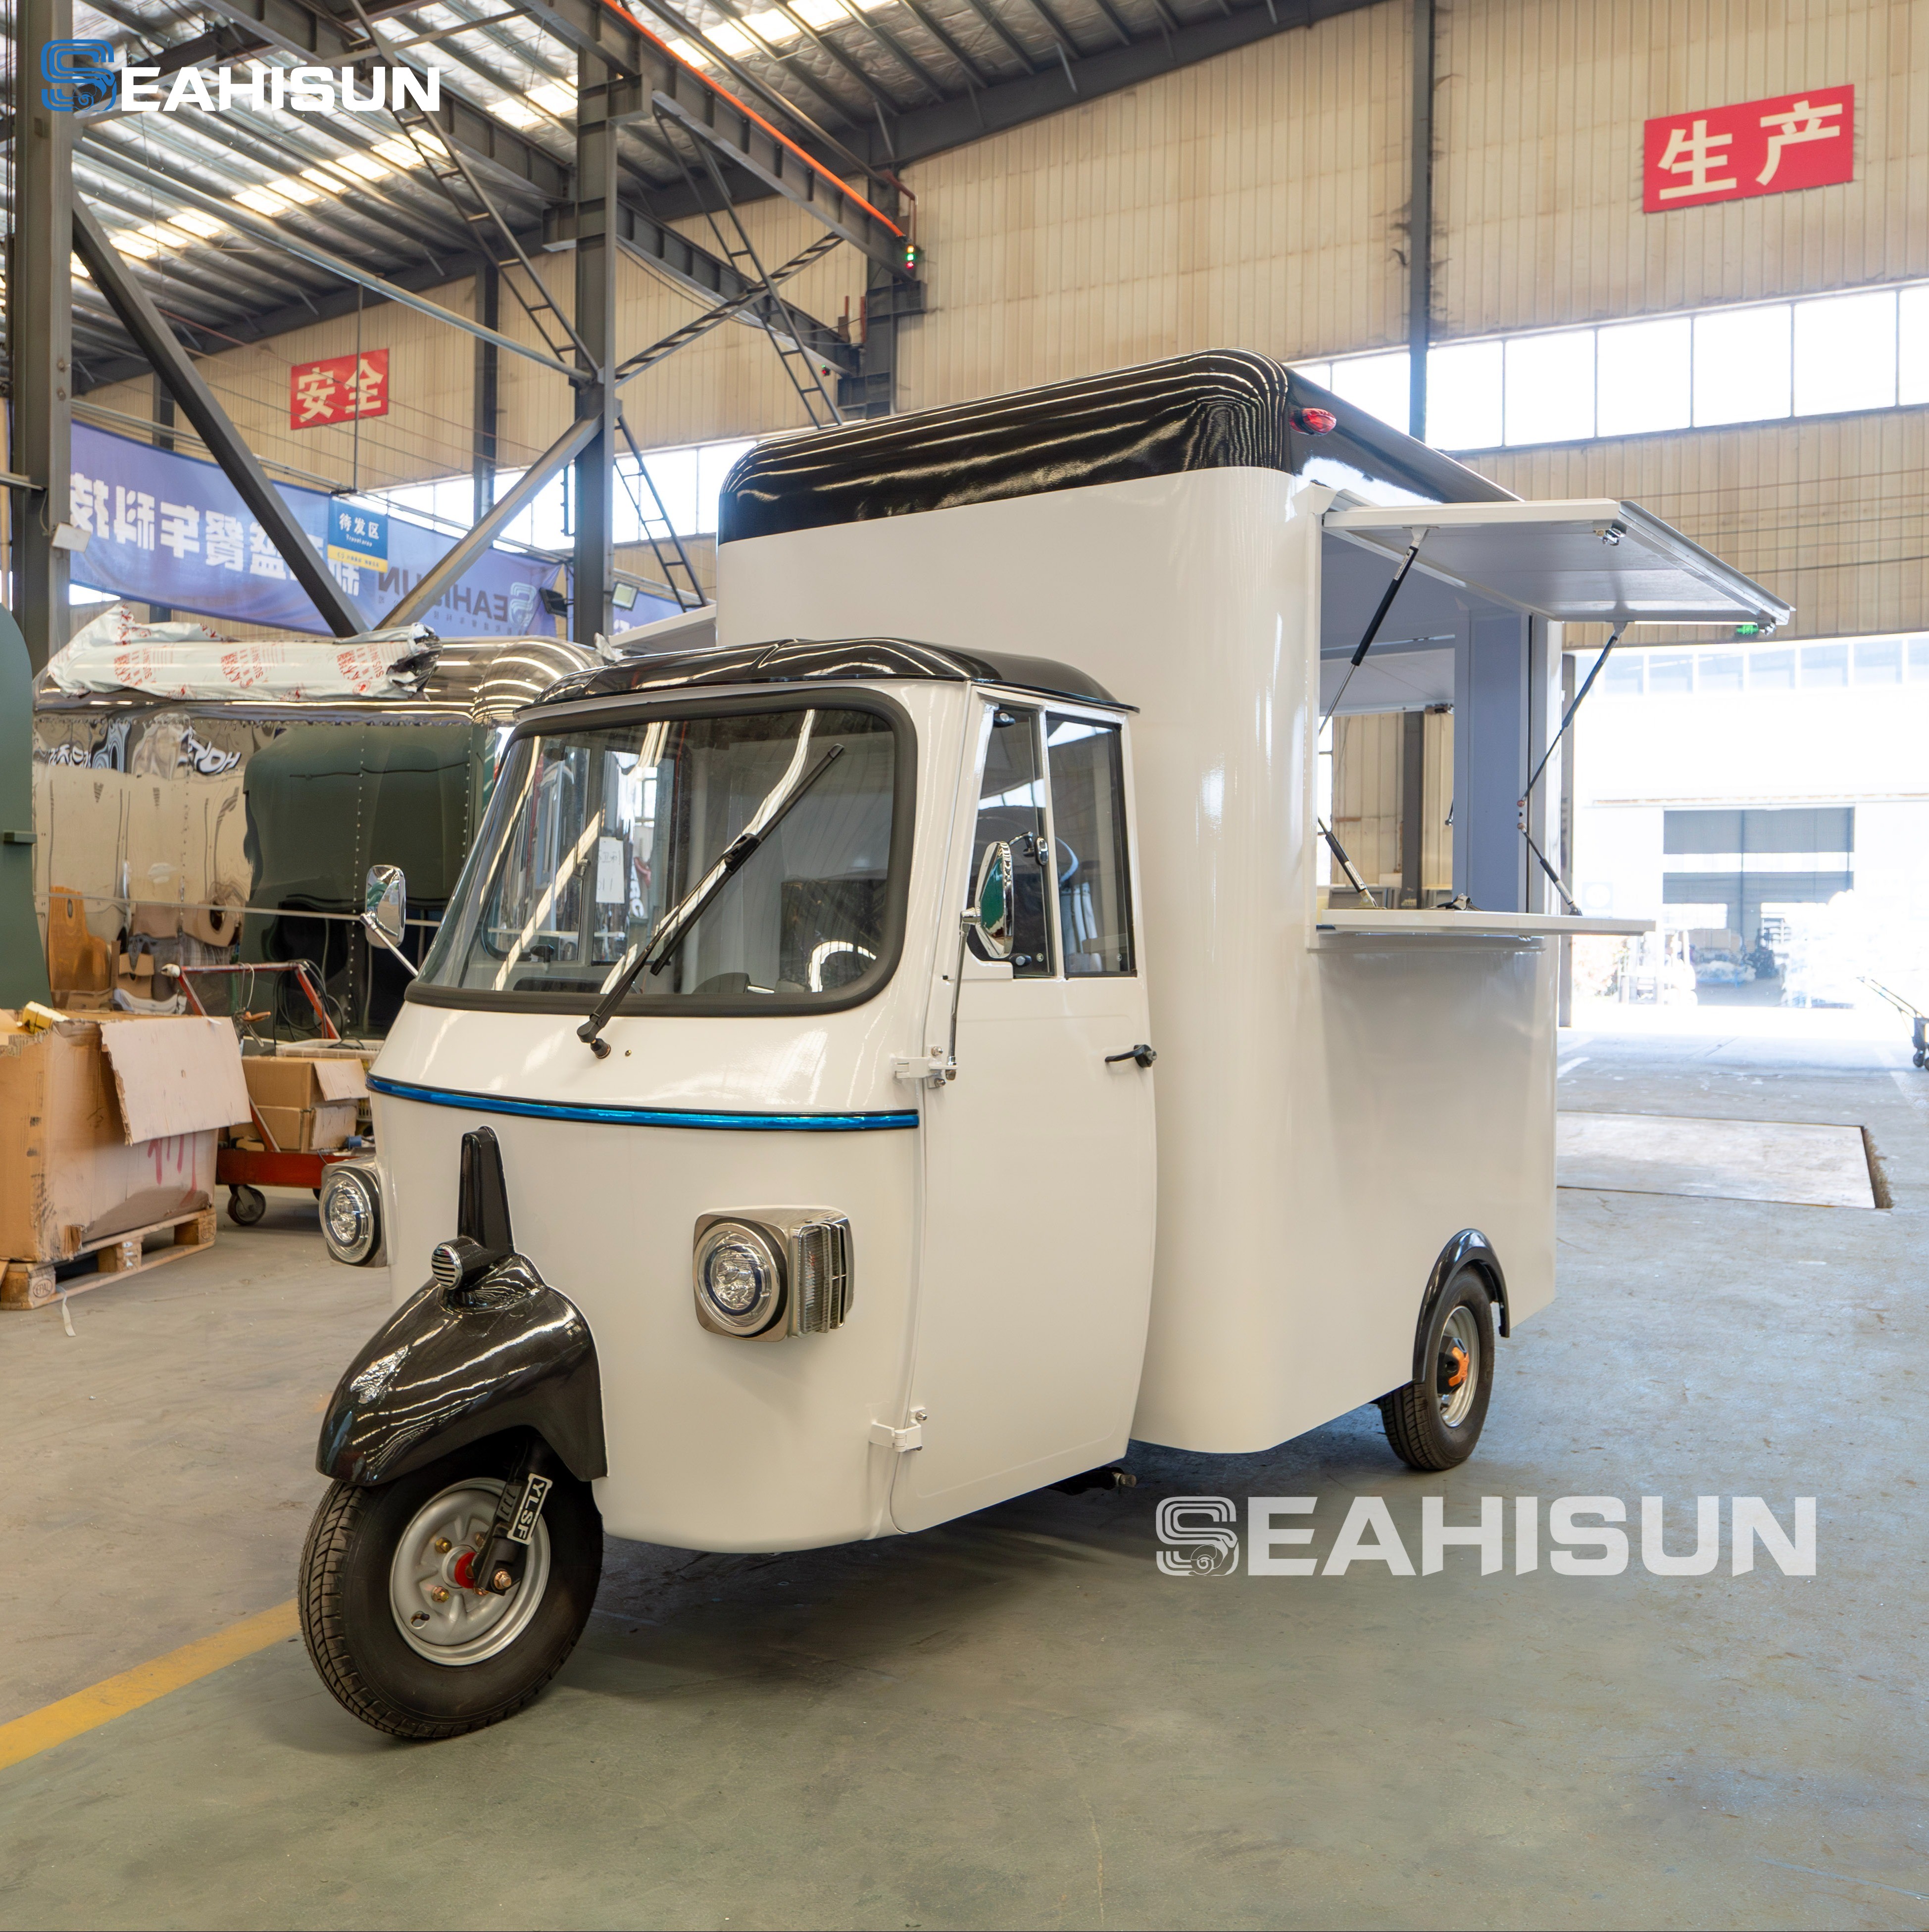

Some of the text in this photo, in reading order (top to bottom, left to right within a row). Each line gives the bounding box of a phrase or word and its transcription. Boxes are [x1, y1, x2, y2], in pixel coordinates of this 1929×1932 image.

[1658, 100, 1842, 200] 生产
[297, 358, 384, 423] 安全
[339, 513, 379, 539] 待发区
[517, 1482, 544, 1539] YLSF
